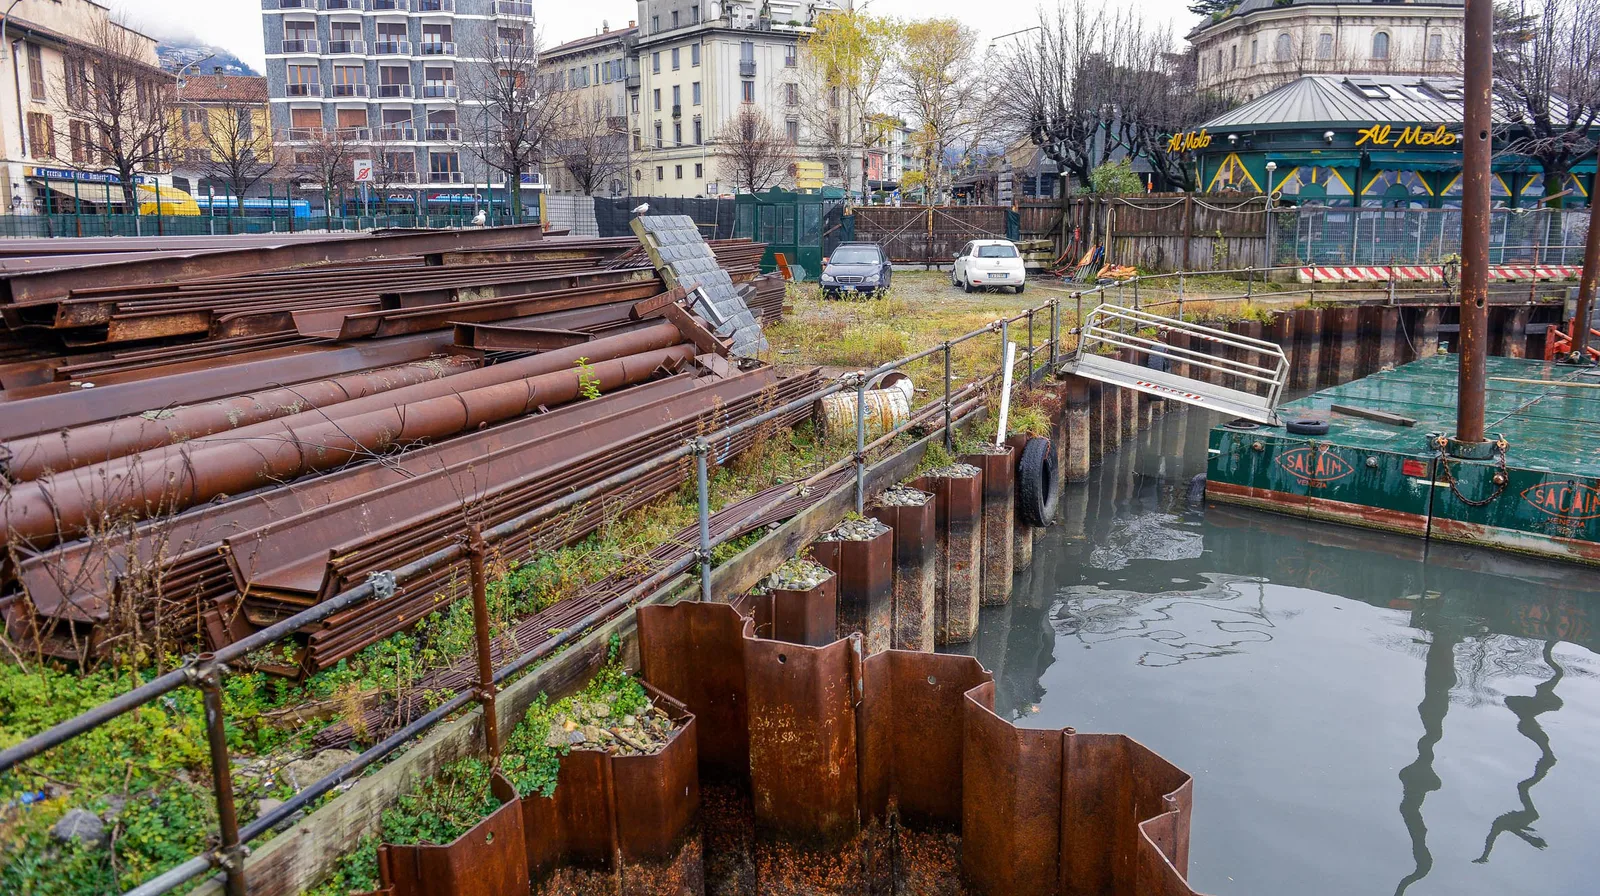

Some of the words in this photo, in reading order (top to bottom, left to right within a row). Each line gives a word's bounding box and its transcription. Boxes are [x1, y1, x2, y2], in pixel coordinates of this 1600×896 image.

[1167, 133, 1183, 153] Al
[1182, 129, 1211, 153] Molo
[1356, 124, 1391, 146] Al
[1393, 125, 1456, 148] Molo
[1287, 453, 1342, 476] SACAIM
